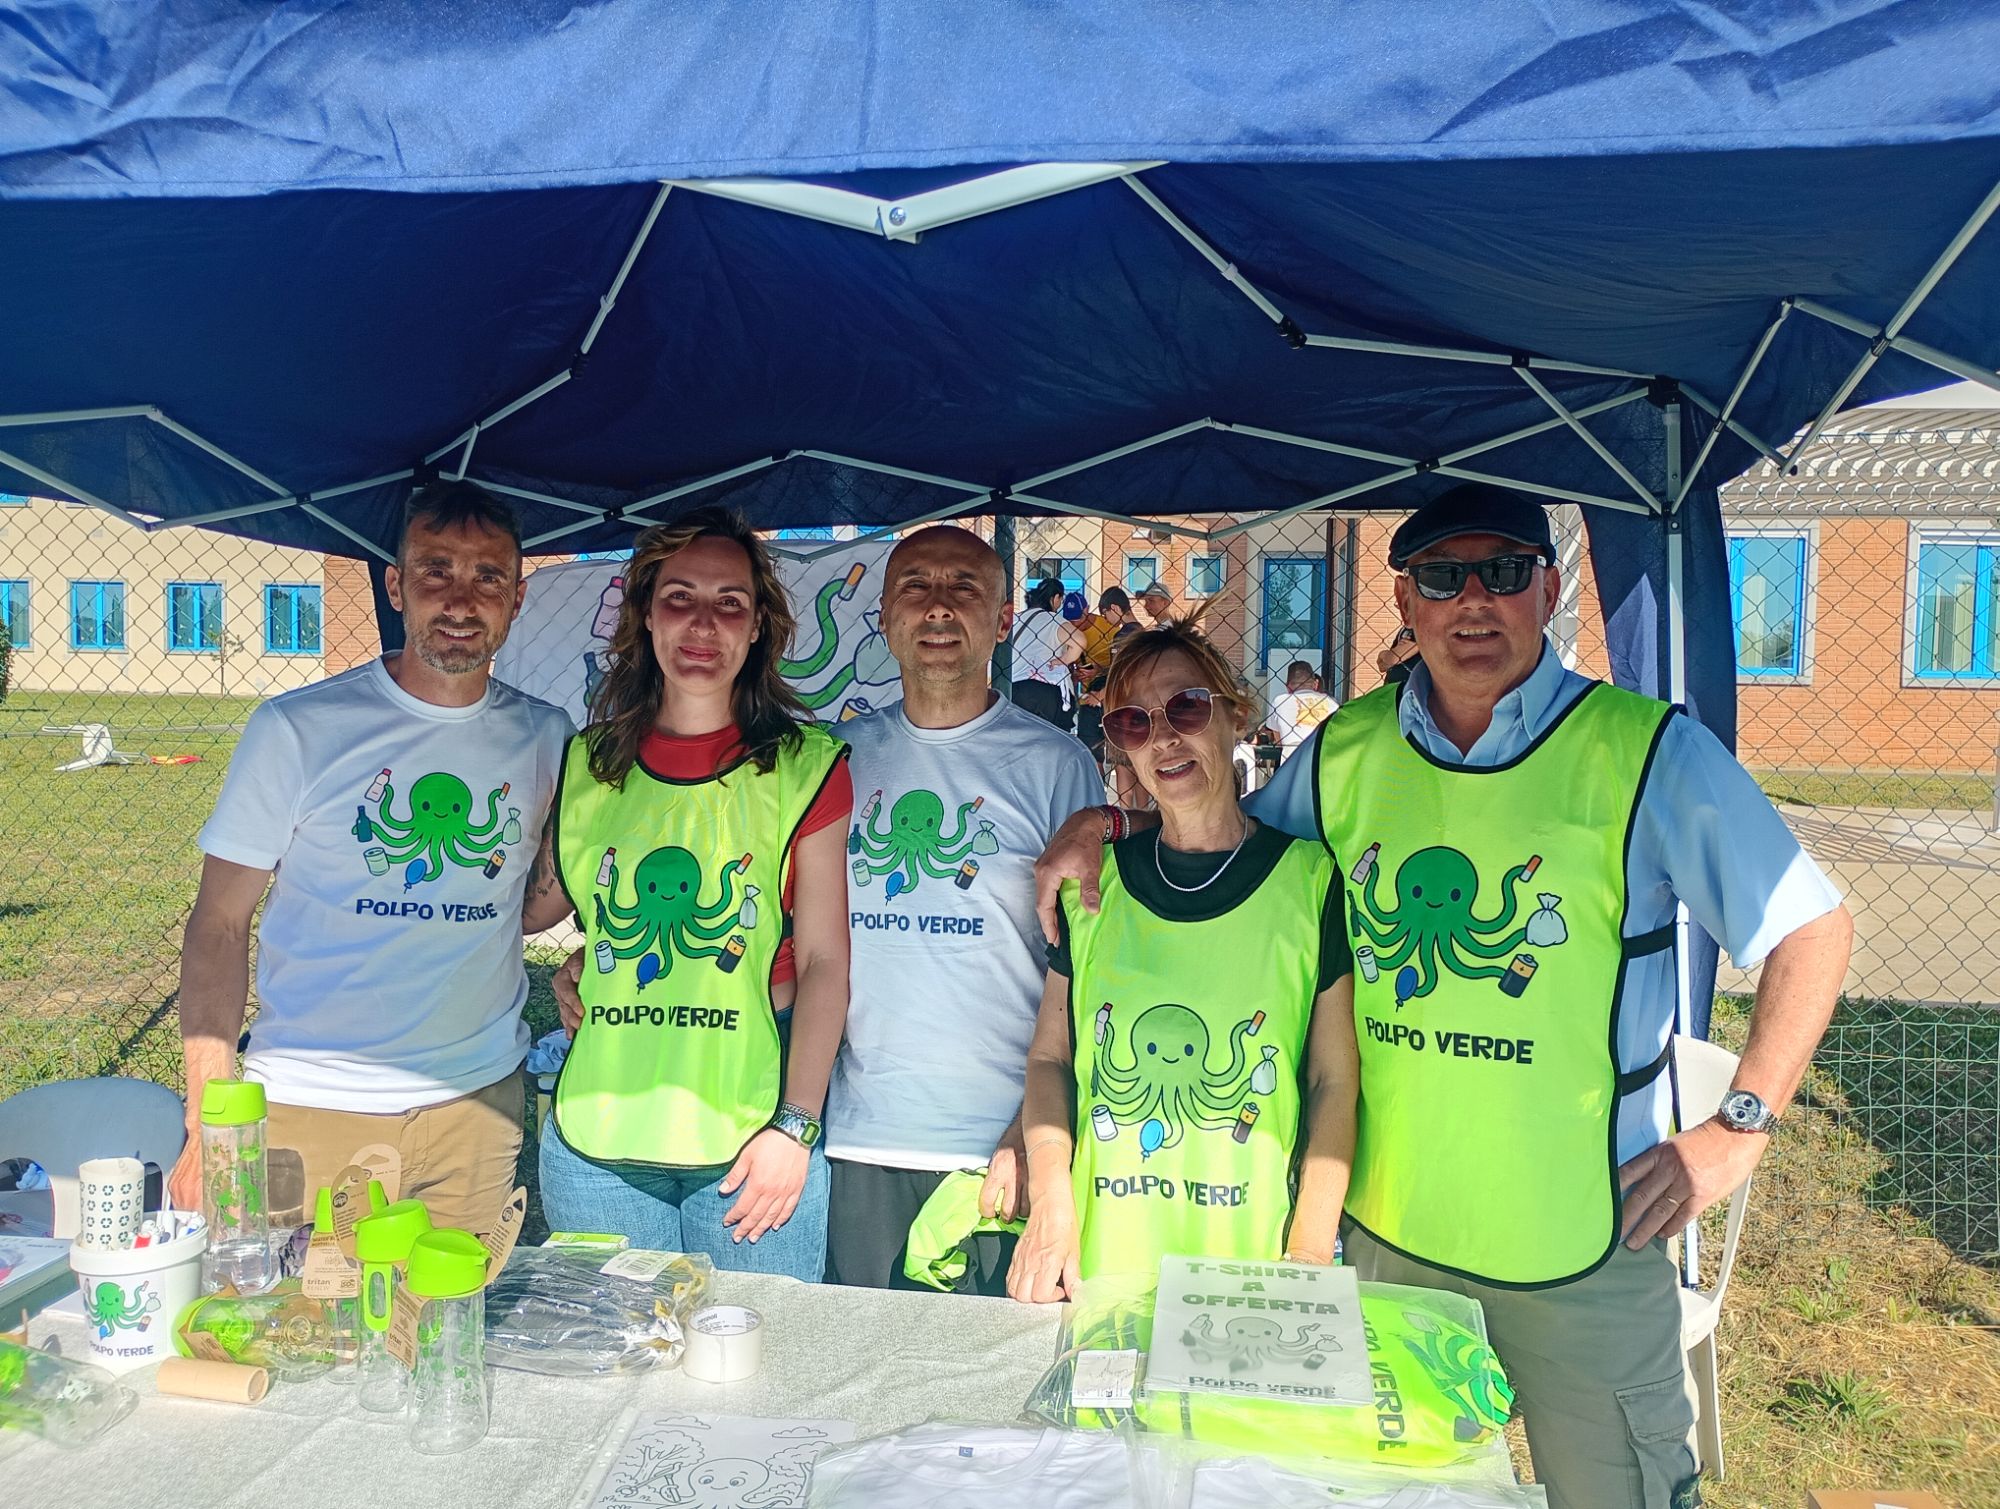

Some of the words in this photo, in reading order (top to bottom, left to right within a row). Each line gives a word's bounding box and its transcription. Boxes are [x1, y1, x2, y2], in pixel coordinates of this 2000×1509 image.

[356, 898, 434, 920] POLPO
[441, 902, 498, 922] VERDE
[850, 912, 910, 931] POLPO
[918, 915, 984, 936] VERDE
[591, 1005, 665, 1026] POLPO
[668, 1005, 740, 1031] VERDE
[1364, 1016, 1426, 1051] POLPO
[1434, 1030, 1534, 1065] VERDE
[1094, 1175, 1175, 1199] POLPO
[1183, 1179, 1250, 1207] VERDE
[1186, 1262, 1321, 1281] T-SHIRT
[1242, 1281, 1265, 1292] A
[1182, 1294, 1340, 1314] OFFERTA
[117, 1345, 154, 1357] VERDE
[1188, 1376, 1260, 1393] POLPO
[1266, 1383, 1336, 1398] VERDE
[1370, 1362, 1408, 1452] VERDE
